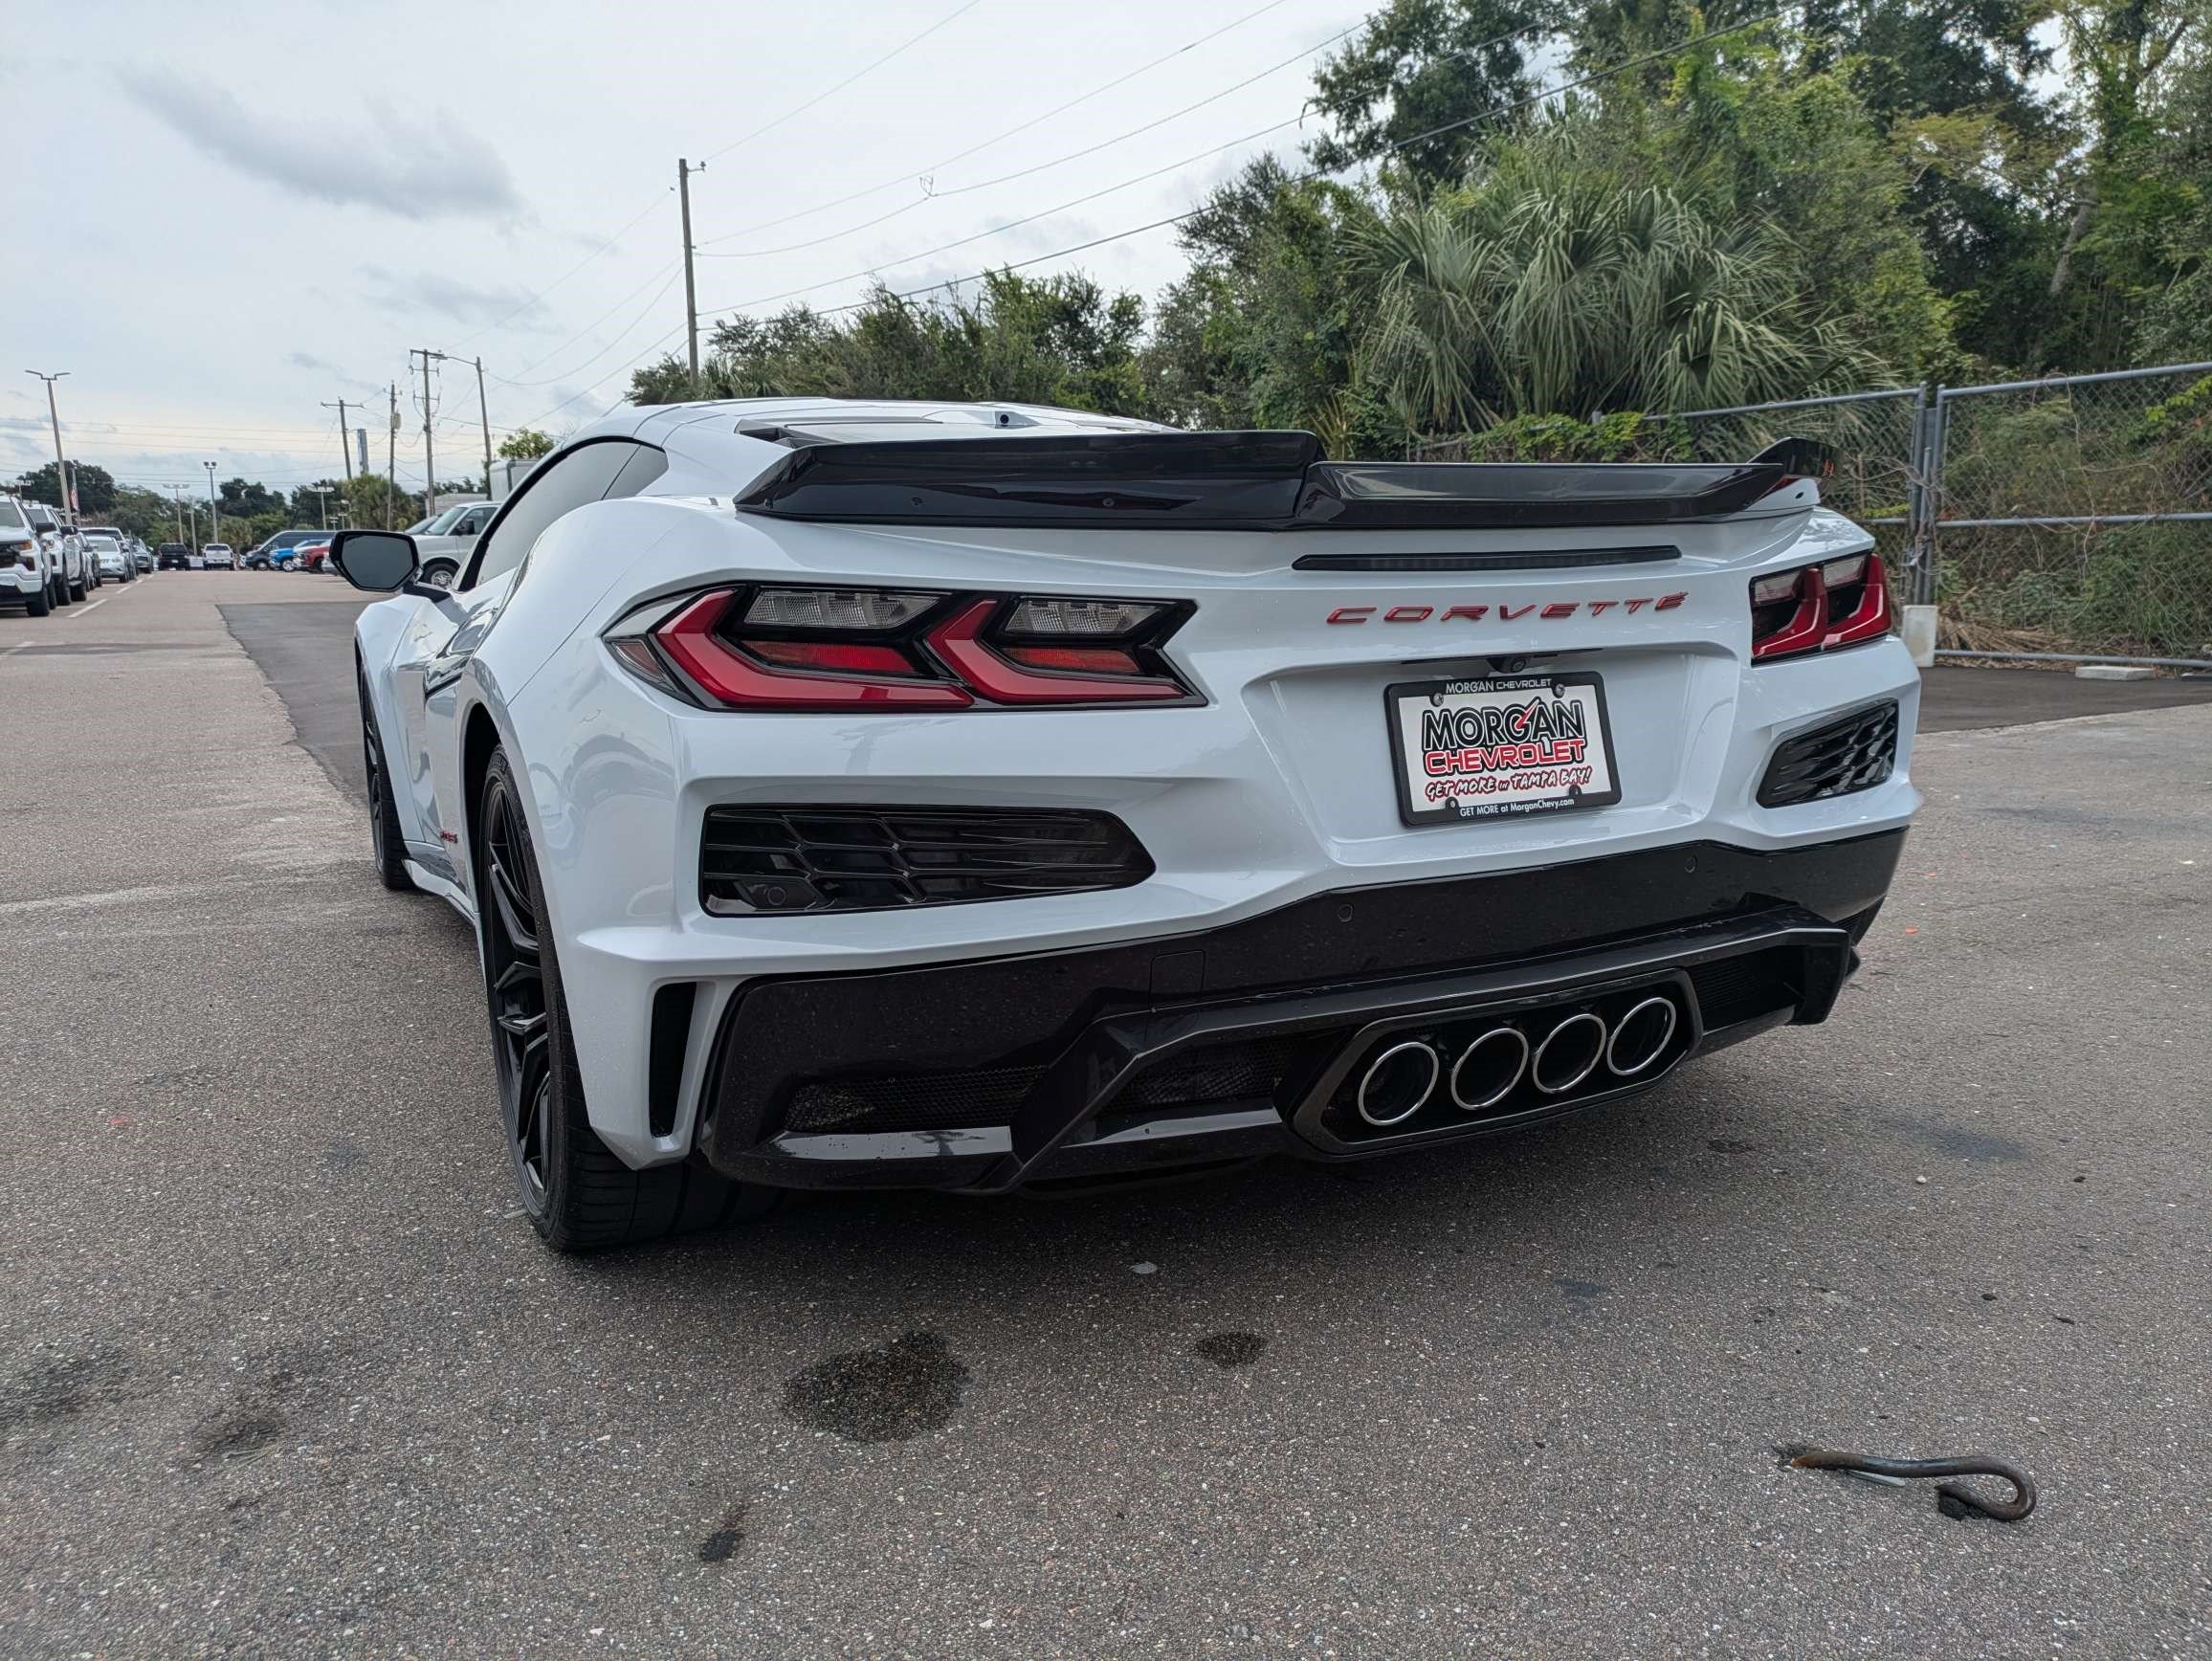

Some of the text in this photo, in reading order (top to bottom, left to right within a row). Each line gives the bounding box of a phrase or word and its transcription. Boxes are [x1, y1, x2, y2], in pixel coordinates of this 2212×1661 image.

[1326, 591, 1689, 624] CORVETTE
[1446, 678, 1552, 694] MORGAN CHEVROLET
[1423, 696, 1587, 752] MORGAN
[1424, 738, 1586, 776] CHEVROLET
[1425, 782, 1456, 803] GET
[1455, 776, 1499, 796] MORE
[1511, 770, 1558, 790] TAMPA
[1558, 765, 1593, 786] BAY!
[1460, 798, 1575, 817] GET MORE at MorganChevy.com
